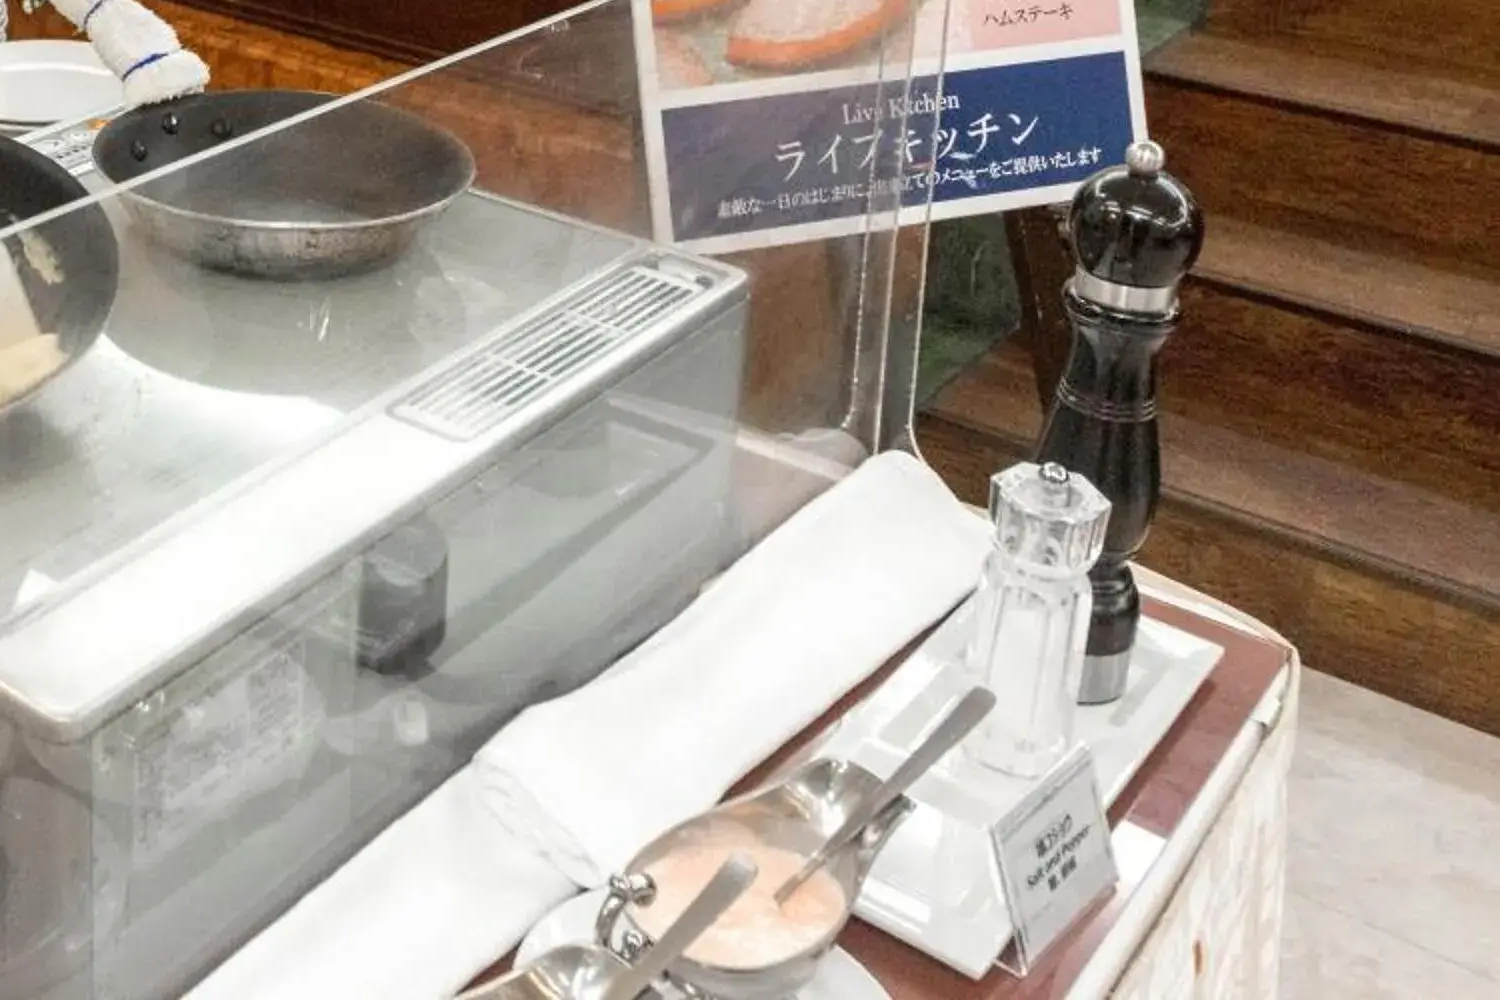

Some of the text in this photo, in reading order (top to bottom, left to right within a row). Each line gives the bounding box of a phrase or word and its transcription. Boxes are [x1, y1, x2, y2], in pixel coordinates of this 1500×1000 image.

[983, 2, 1074, 27] ハムステーキ
